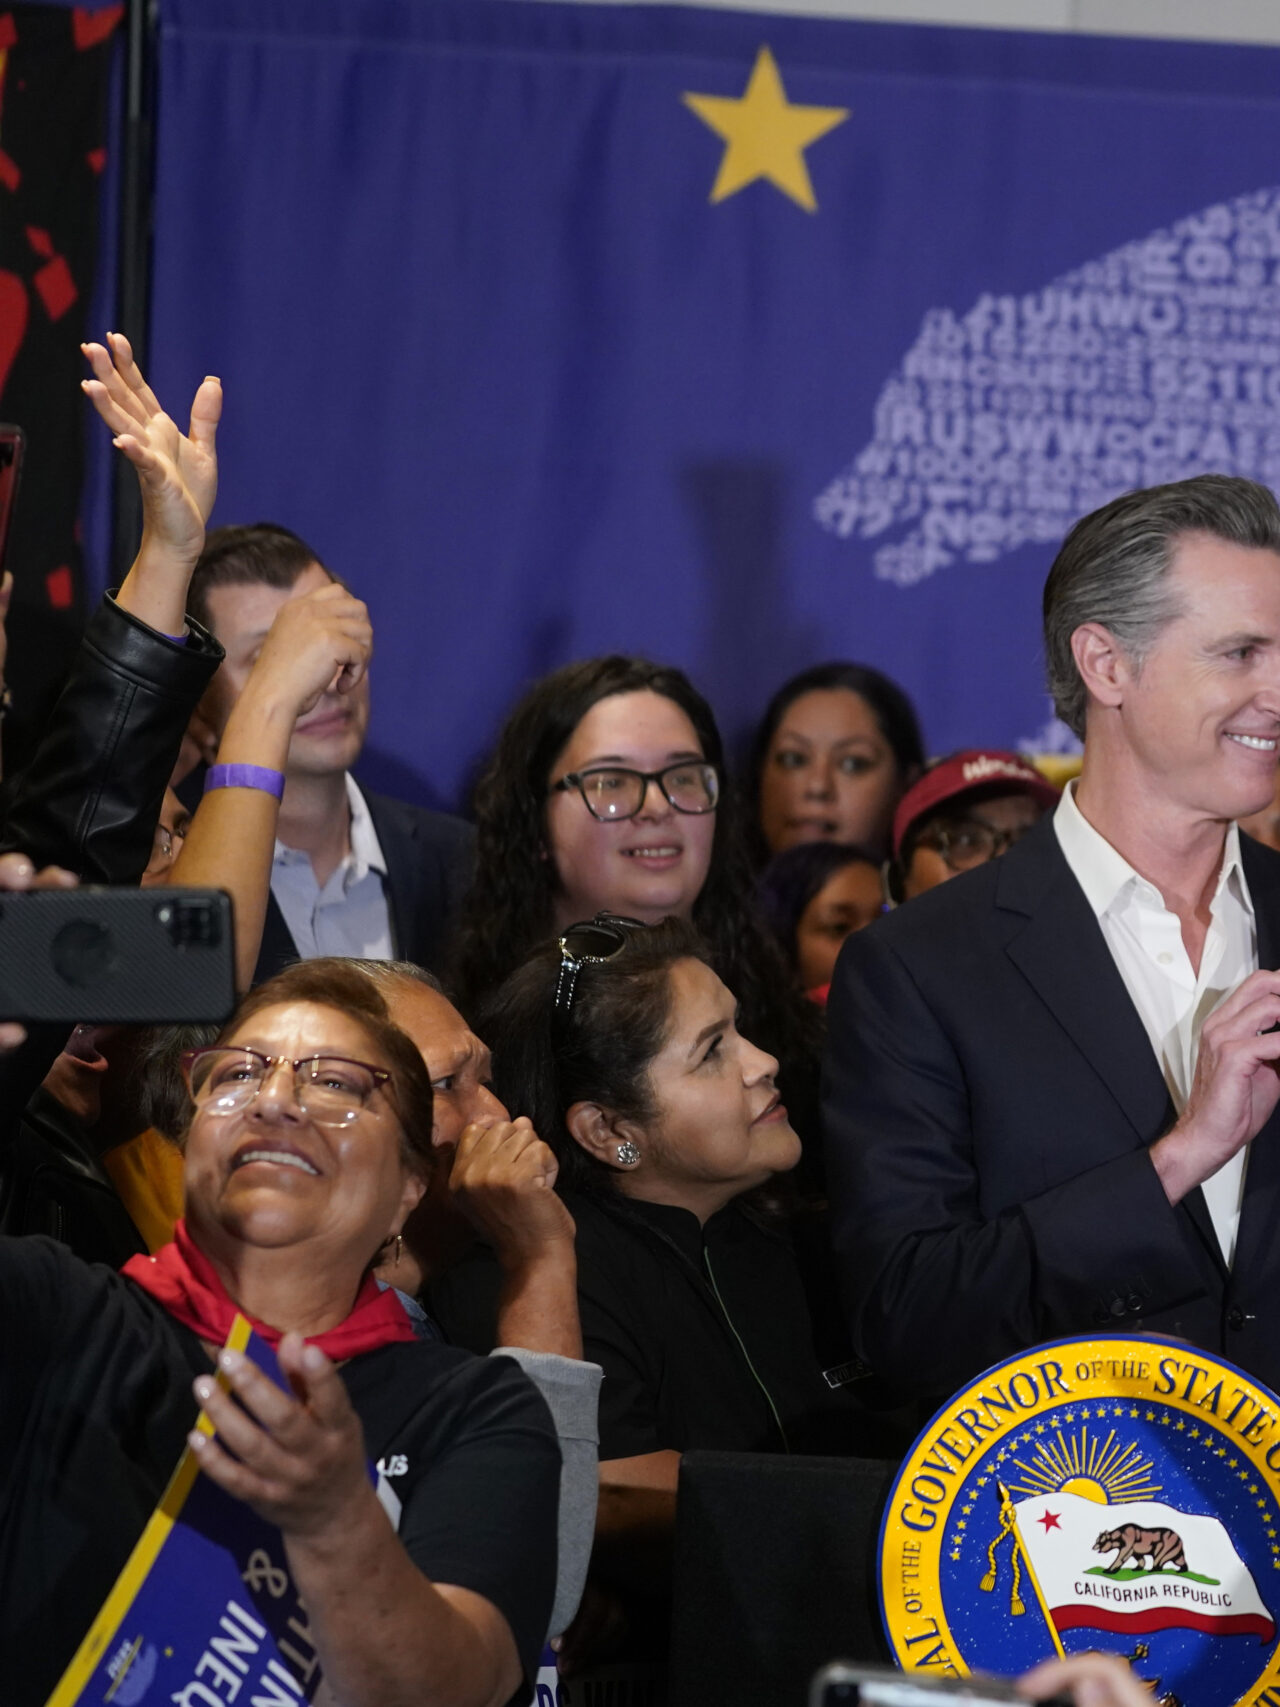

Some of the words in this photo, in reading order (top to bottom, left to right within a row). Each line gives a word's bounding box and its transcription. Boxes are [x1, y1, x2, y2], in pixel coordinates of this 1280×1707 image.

[1022, 292, 1138, 327] UHW
[932, 411, 1102, 453] USWW
[1075, 1361, 1102, 1381] OF
[1104, 1360, 1150, 1381] THE
[1153, 1358, 1277, 1447] STATE
[900, 1360, 1075, 1533] GOVERNOR
[901, 1540, 922, 1583] THE
[903, 1586, 922, 1613] OF
[1074, 1581, 1158, 1602] CALIFORNIA
[1162, 1584, 1232, 1606] REPUBLIC
